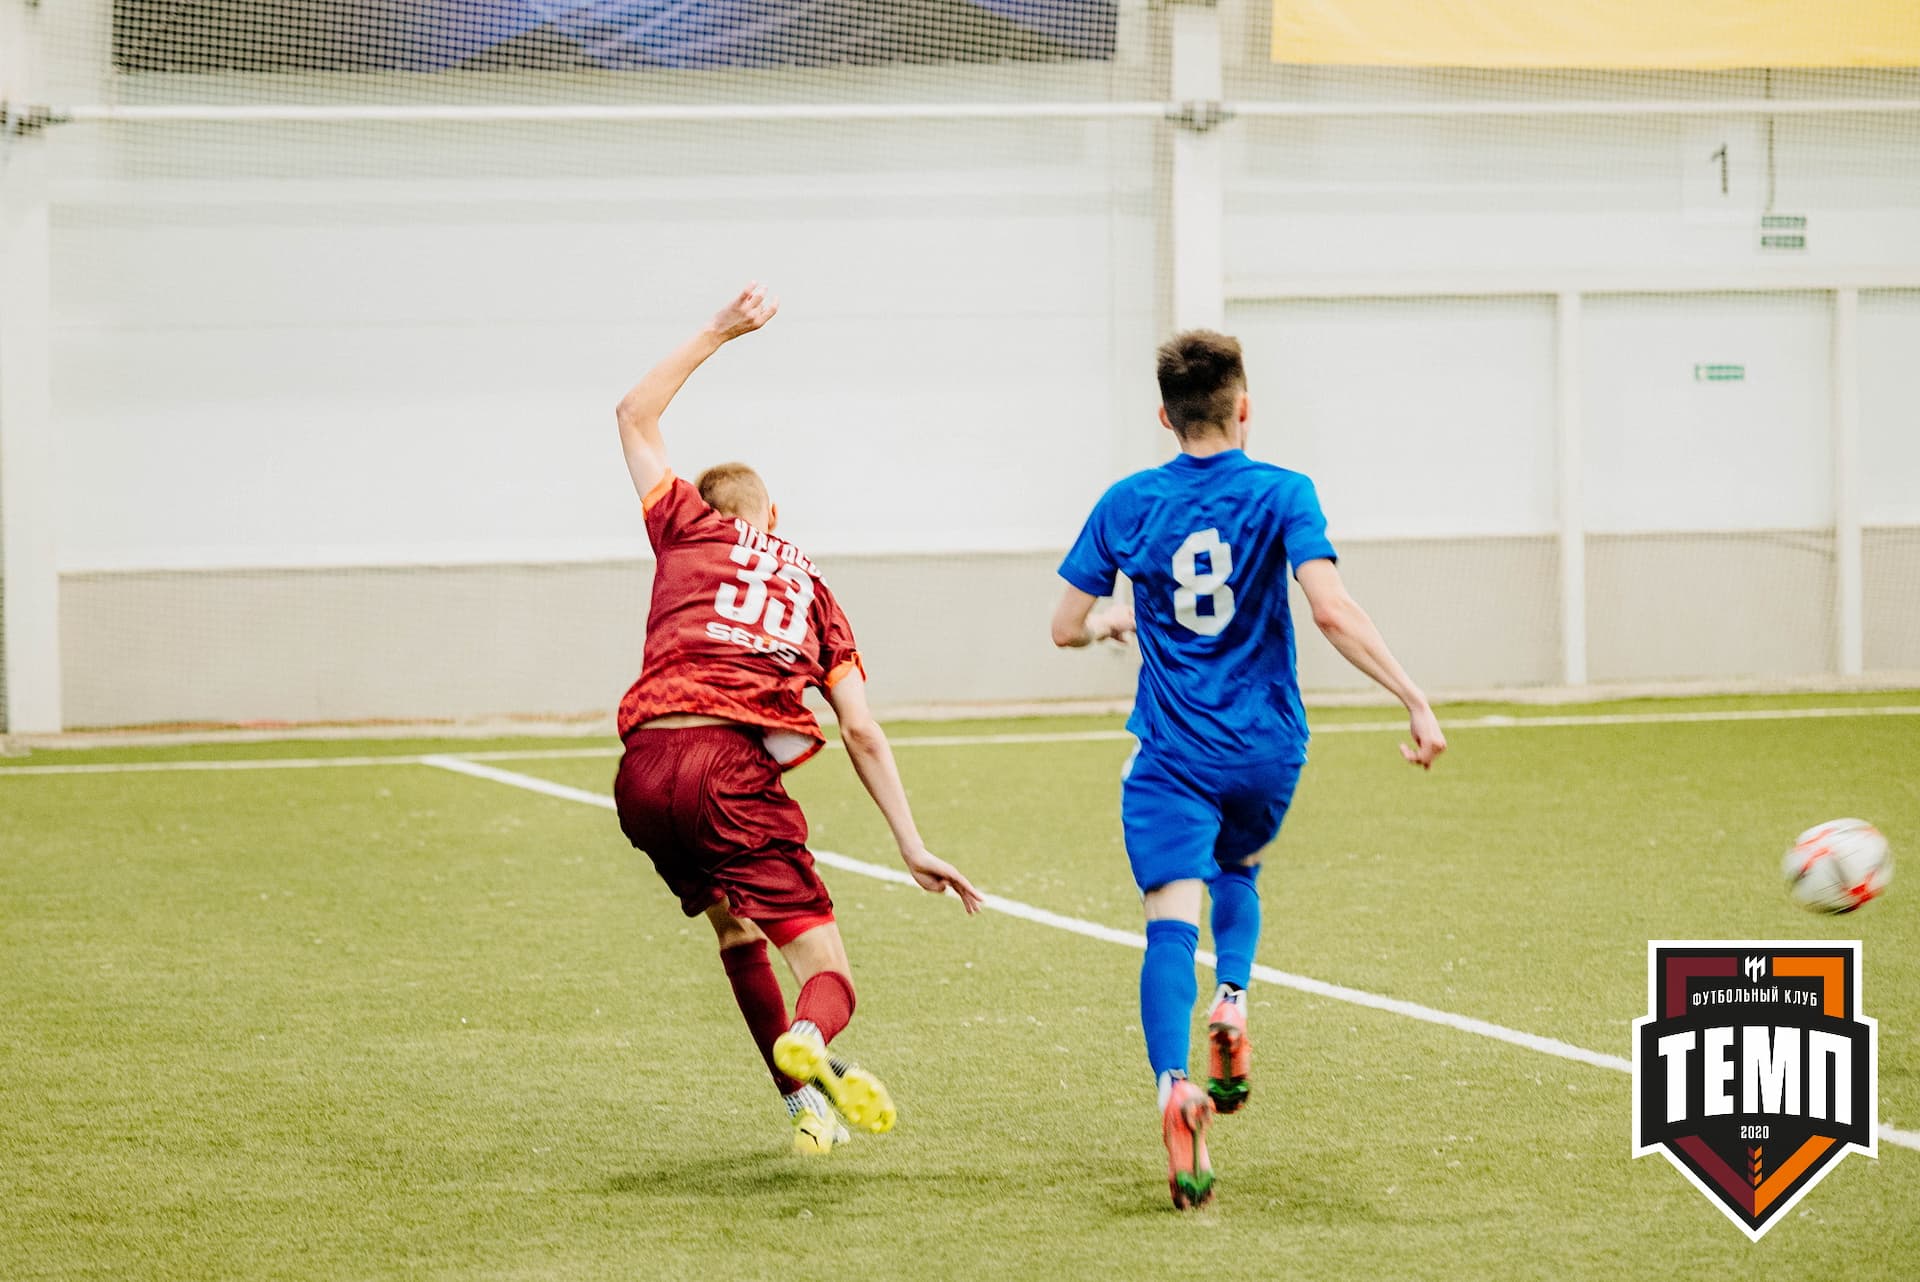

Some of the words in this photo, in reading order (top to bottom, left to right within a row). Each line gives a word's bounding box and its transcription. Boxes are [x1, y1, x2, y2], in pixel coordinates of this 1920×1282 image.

[1709, 143, 1728, 194] 1
[714, 544, 815, 645] 33
[1172, 528, 1236, 637] 8
